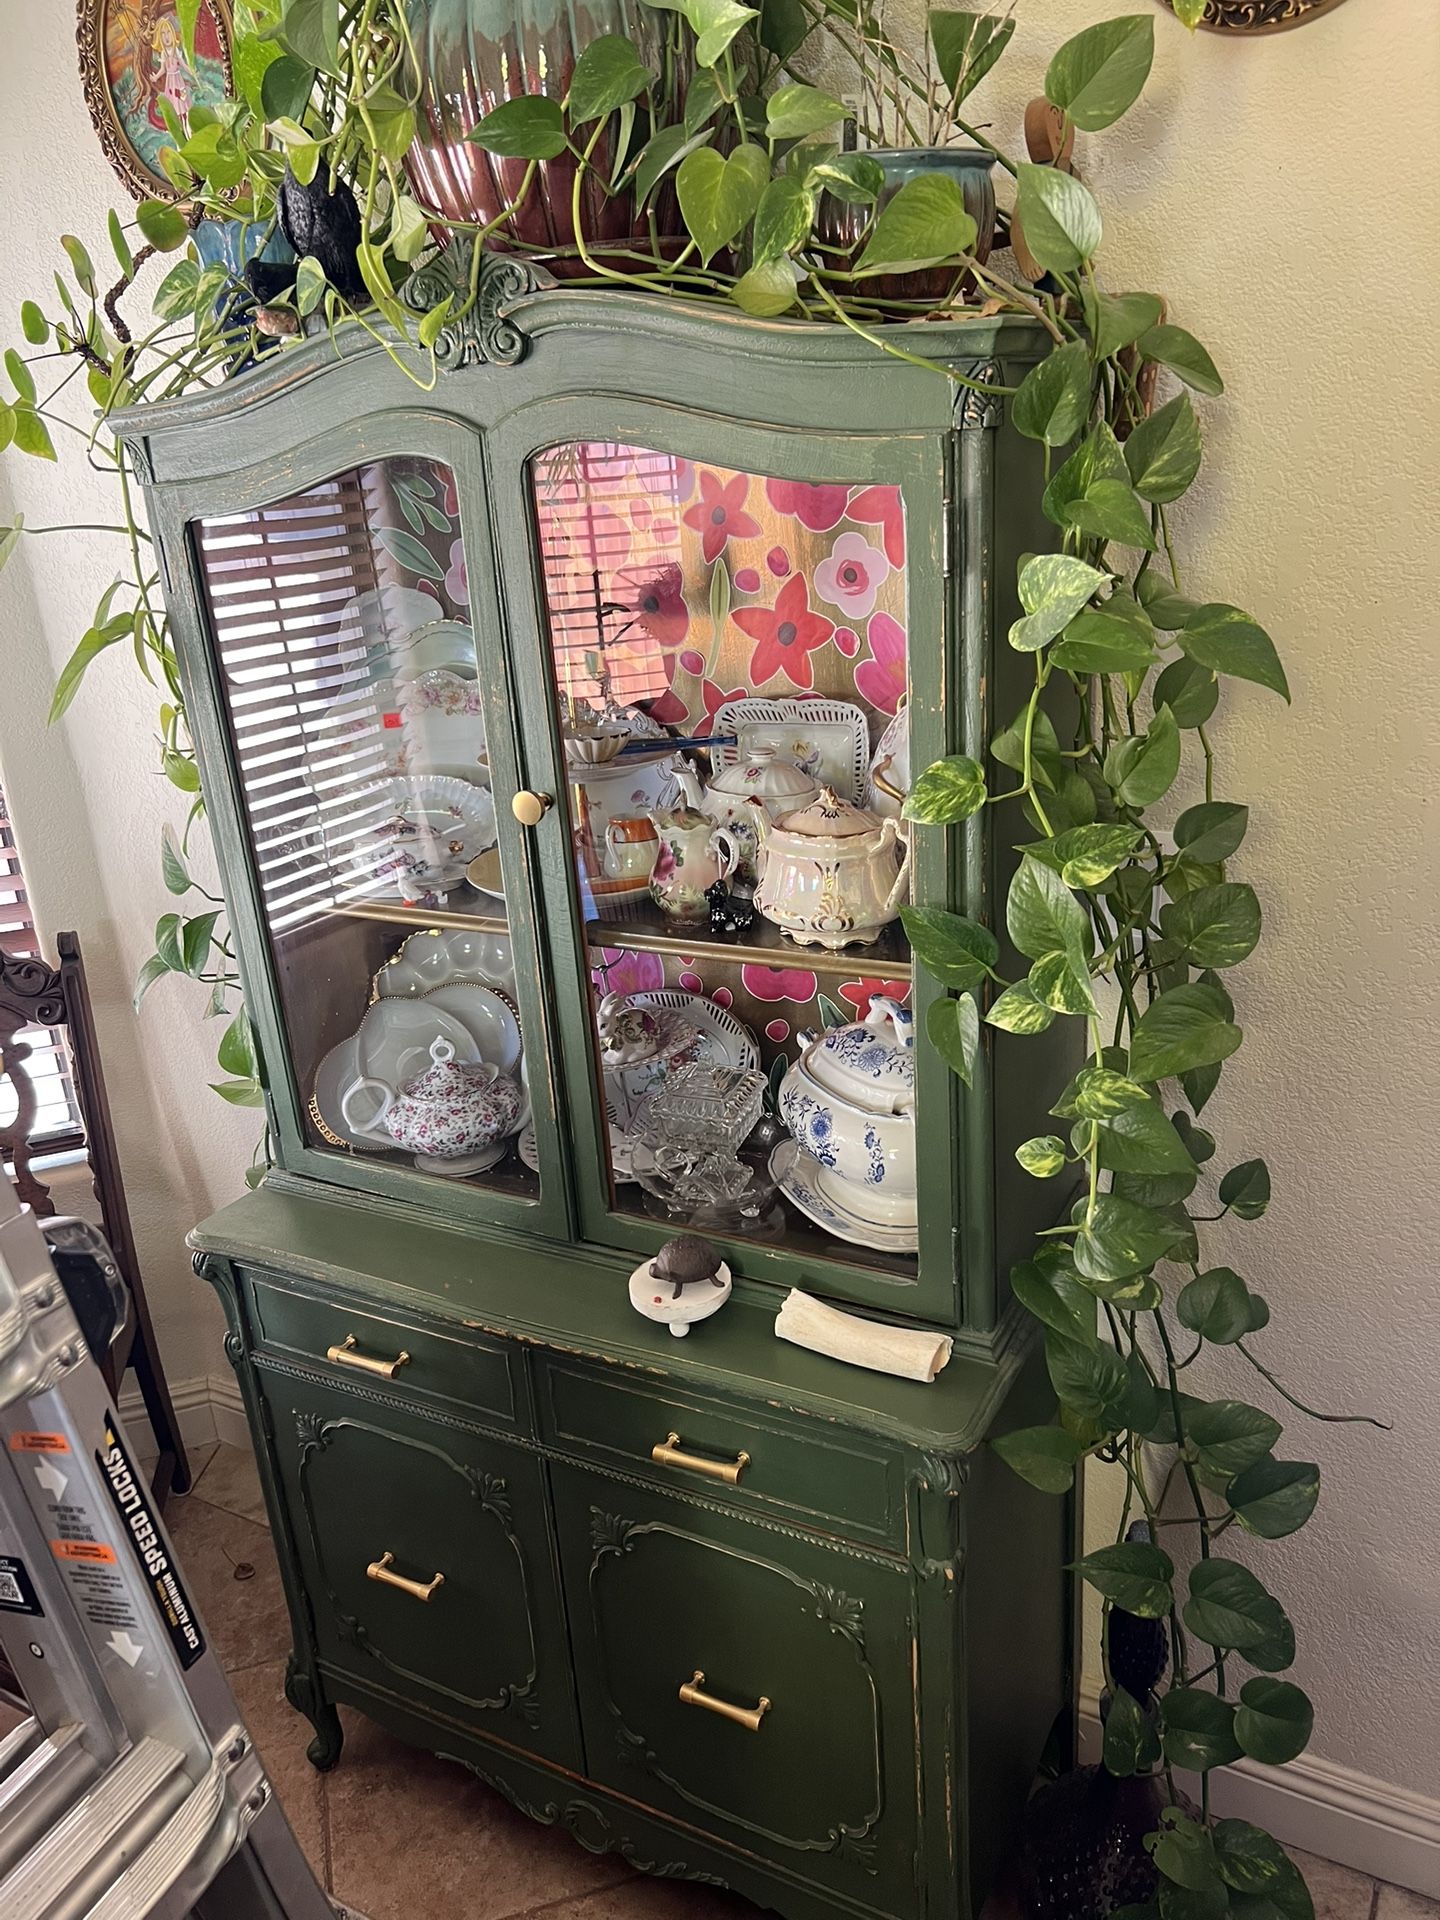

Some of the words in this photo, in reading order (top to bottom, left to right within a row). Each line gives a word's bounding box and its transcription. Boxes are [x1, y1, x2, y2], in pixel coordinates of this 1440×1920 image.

[103, 1447, 142, 1514] LOCKS
[130, 1510, 168, 1576] SPEED
[162, 1571, 190, 1624] ALUMINUM
[182, 1623, 199, 1649] CAST
